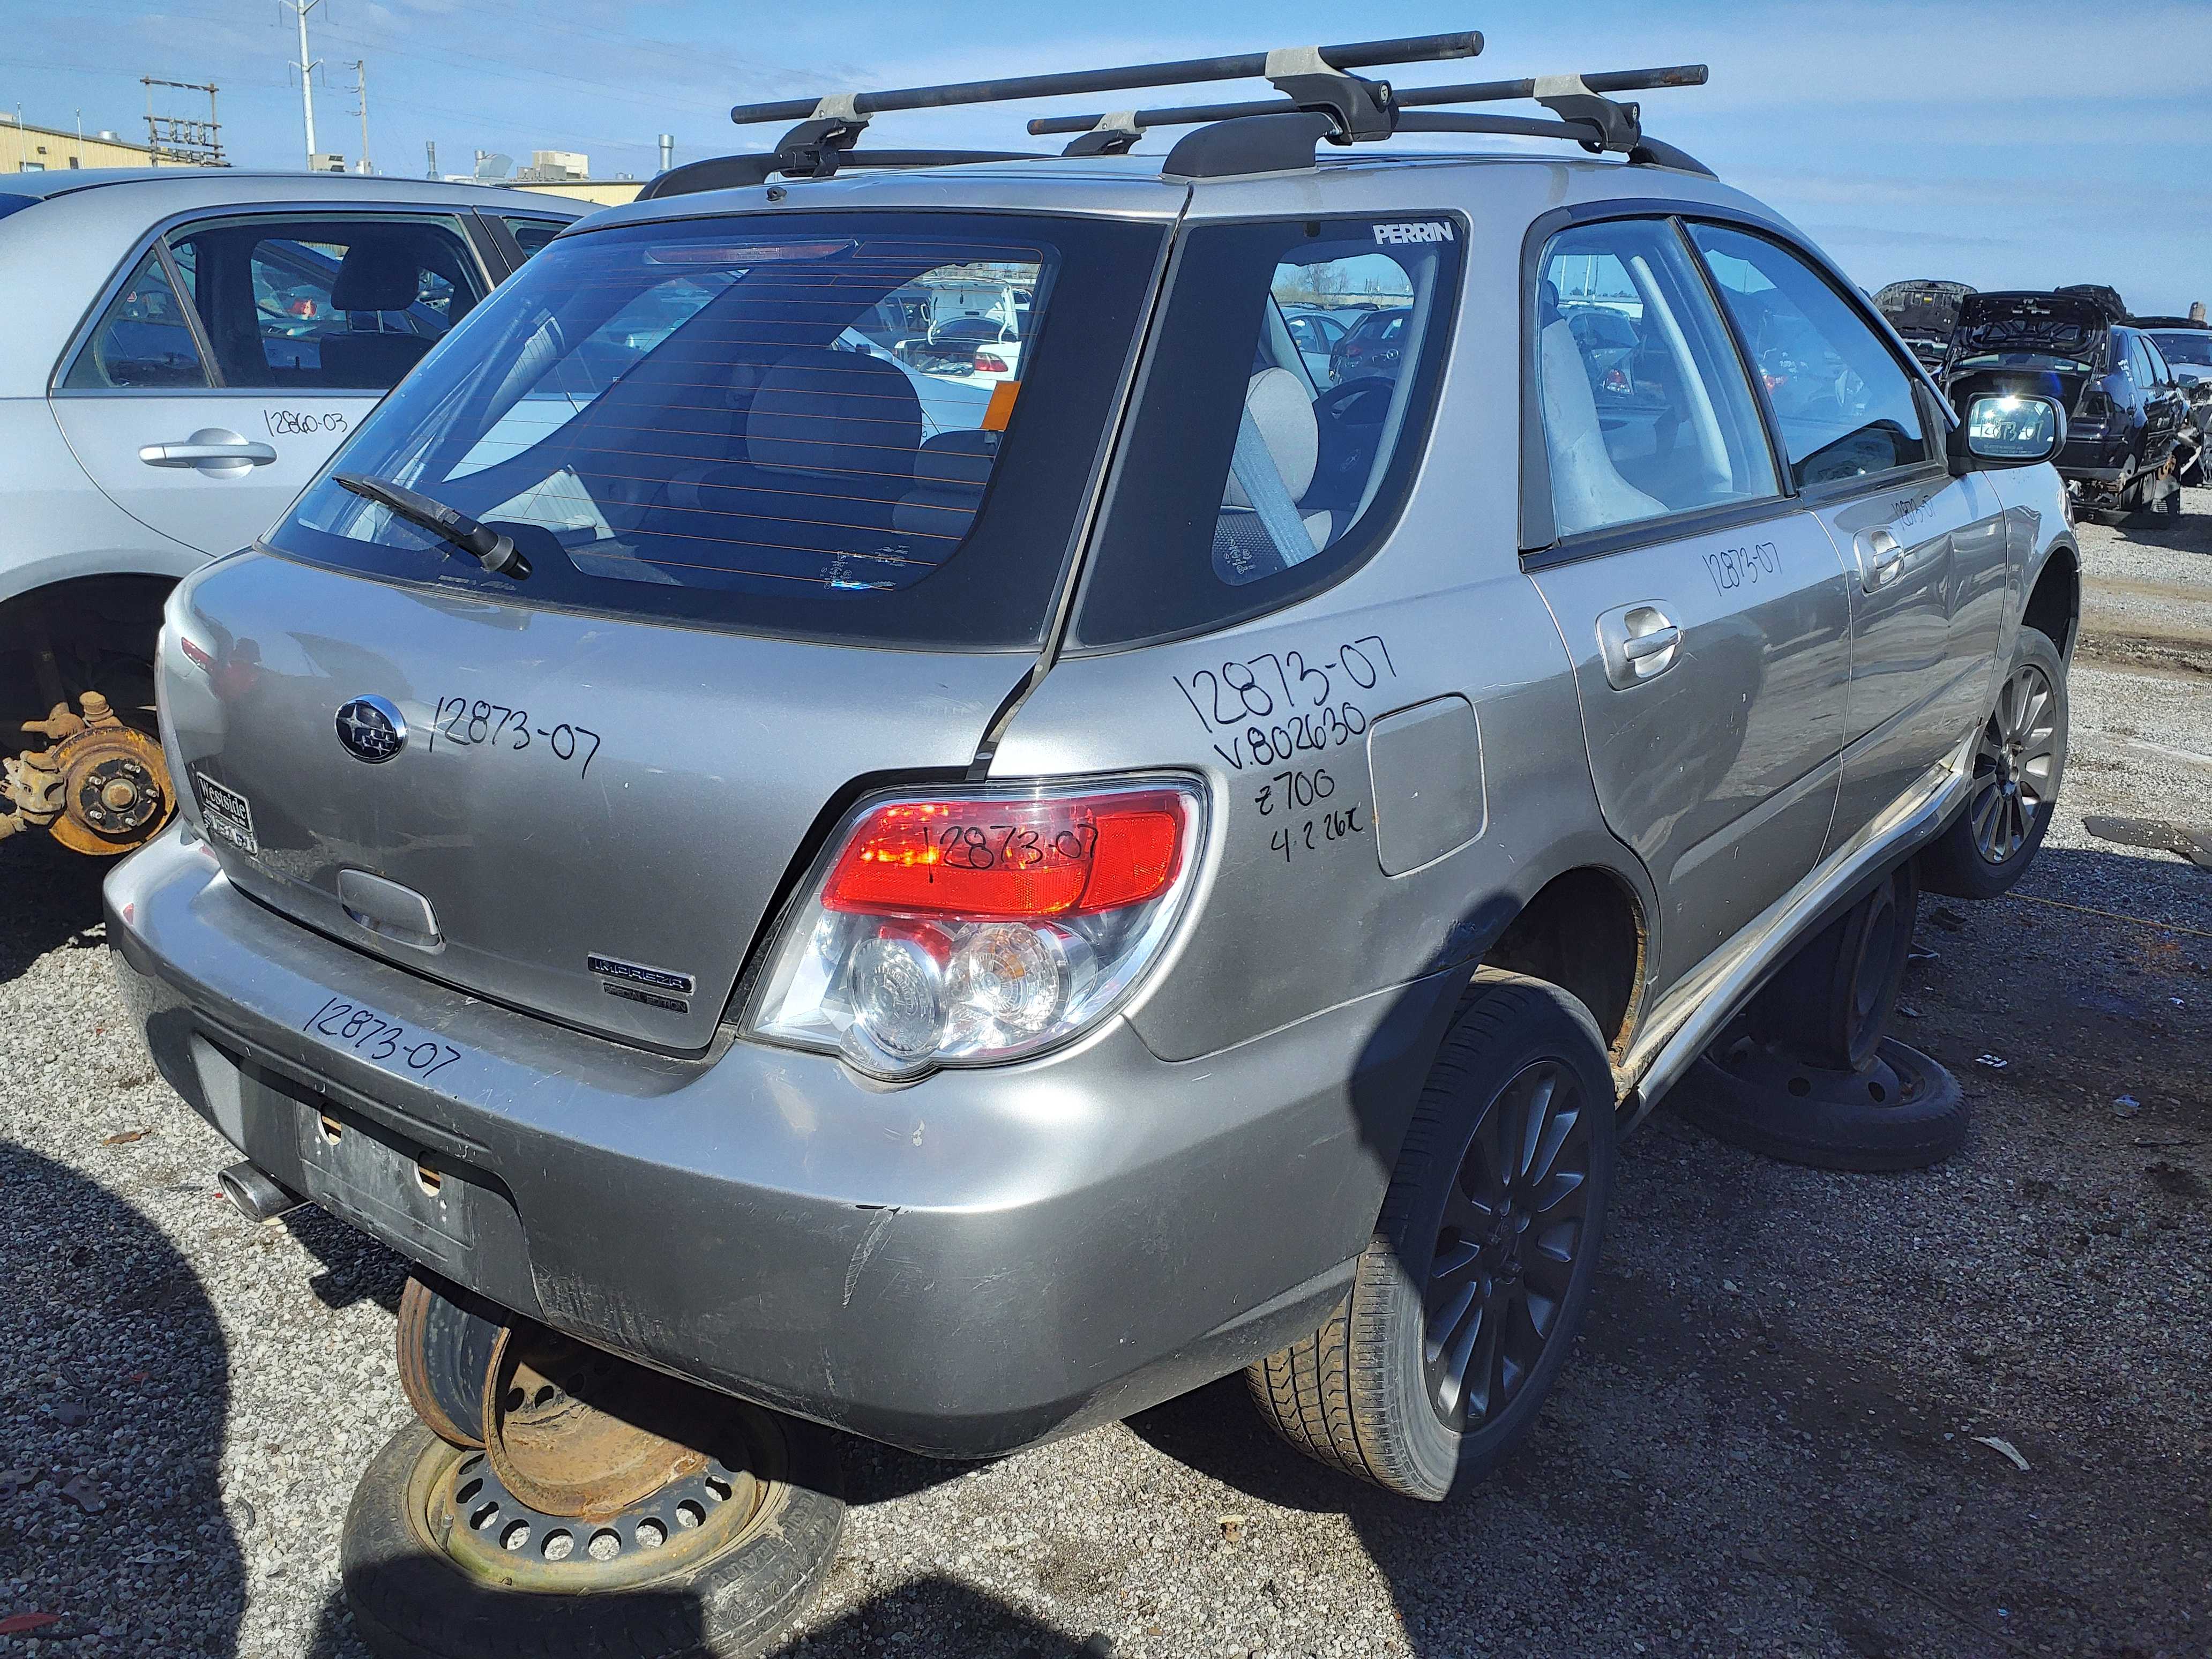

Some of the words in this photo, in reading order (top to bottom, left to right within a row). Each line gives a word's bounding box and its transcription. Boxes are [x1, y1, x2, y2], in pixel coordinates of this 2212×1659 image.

[1372, 222, 1454, 245] PERRIN
[264, 409, 347, 437] 12860-03
[1702, 542, 1782, 596] 12873-07
[1174, 636, 1396, 733] 12873-07
[429, 696, 601, 779] 12873-07
[199, 778, 246, 820] Westside
[923, 824, 1098, 884] 12873-07
[594, 959, 684, 989] IMPREZA
[304, 997, 462, 1078] 12873-07
